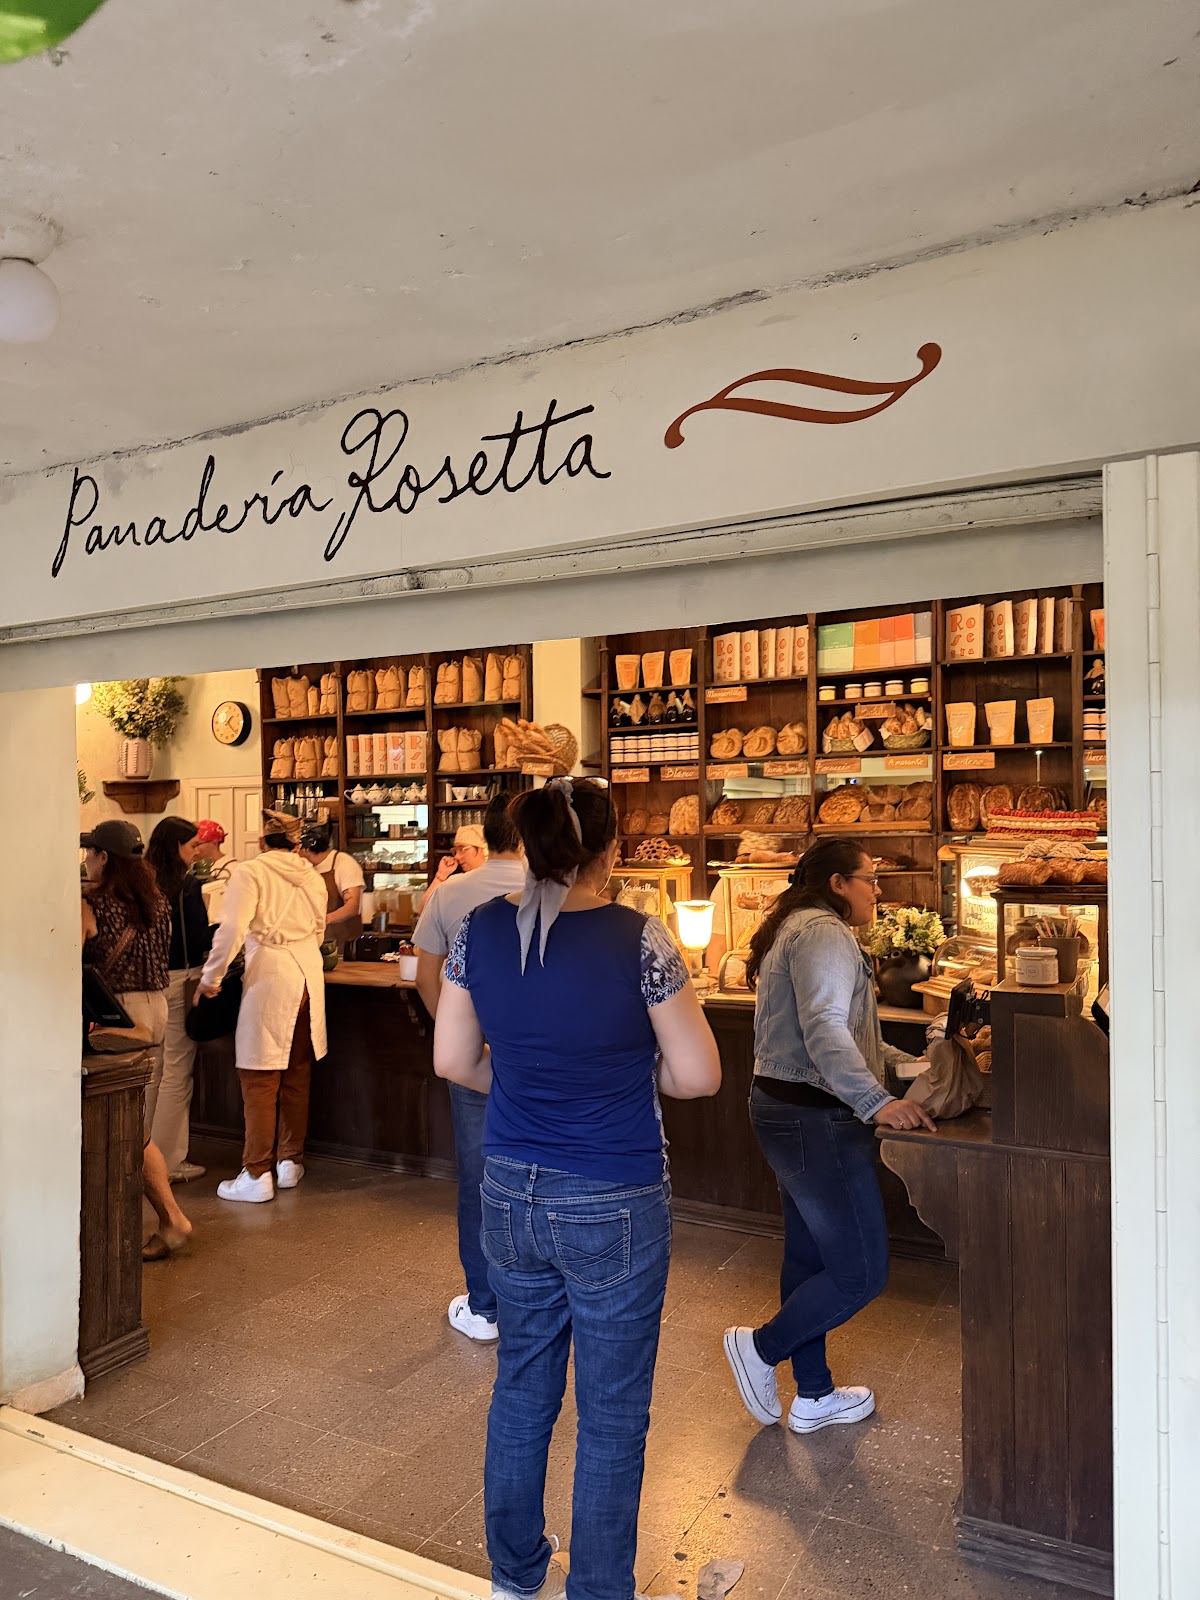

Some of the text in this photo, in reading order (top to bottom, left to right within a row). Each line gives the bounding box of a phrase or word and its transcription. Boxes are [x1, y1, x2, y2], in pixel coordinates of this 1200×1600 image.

[52, 399, 612, 577] Panadería Rosetta
[665, 767, 694, 779] Blanco
